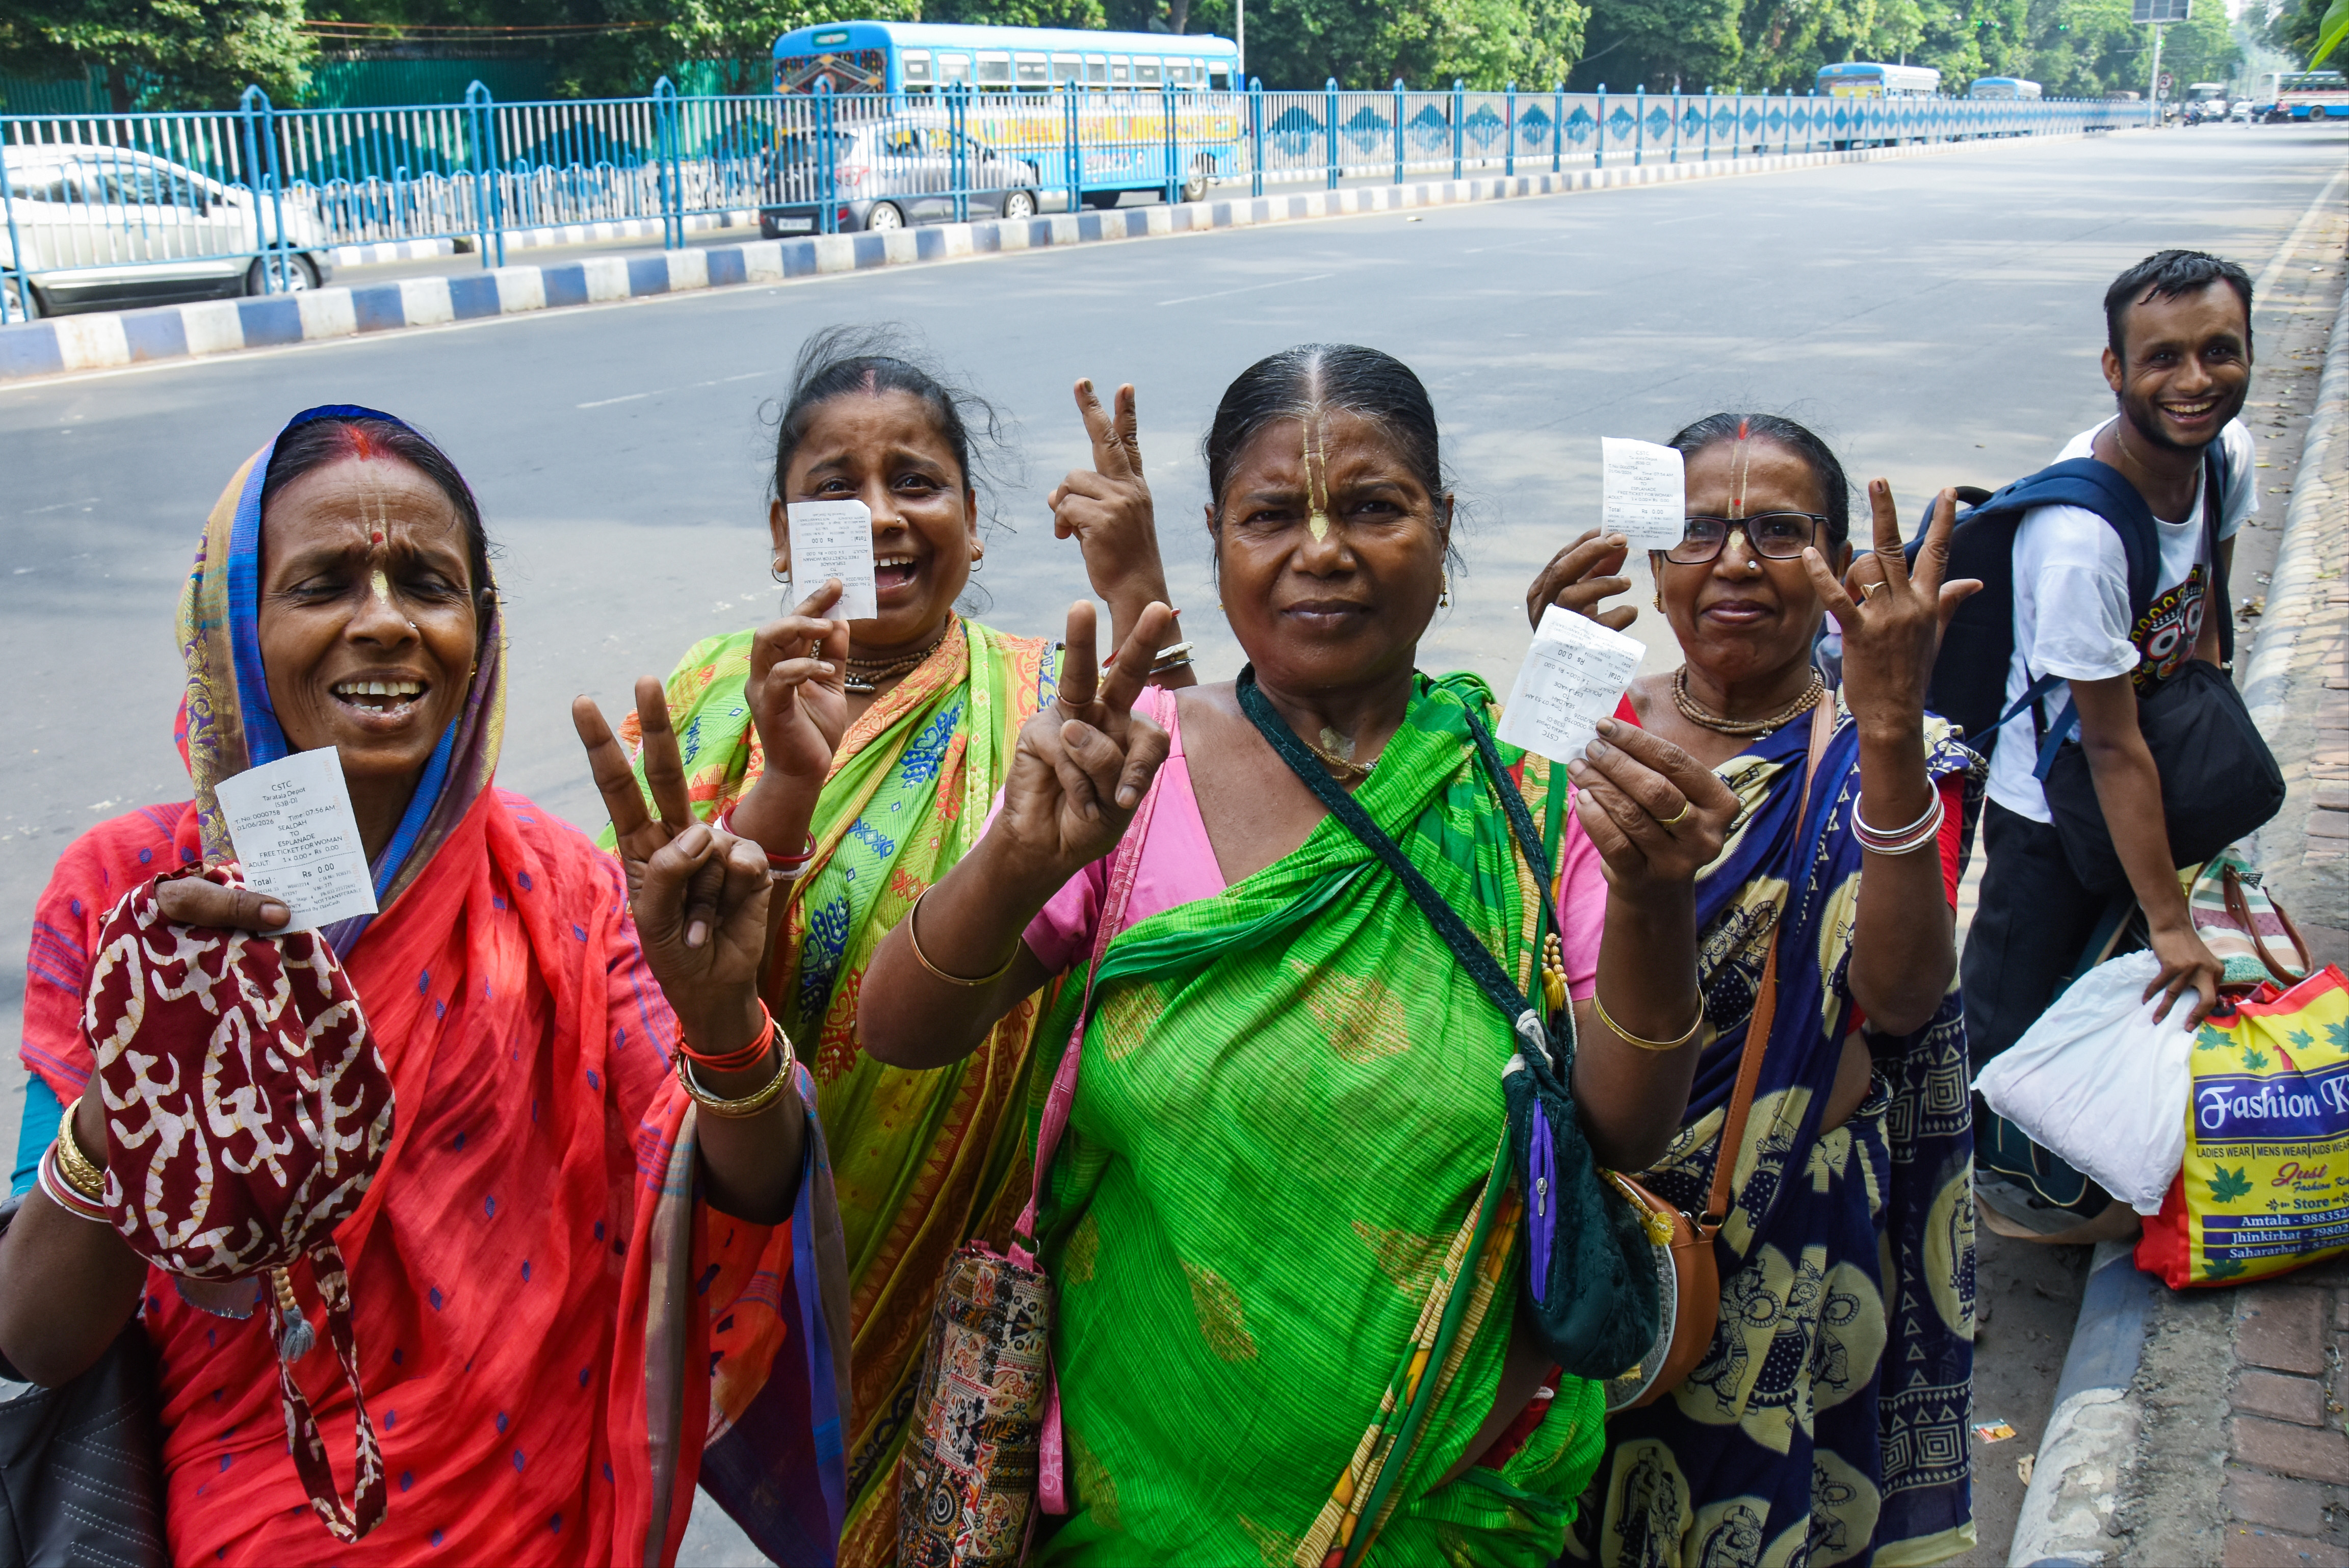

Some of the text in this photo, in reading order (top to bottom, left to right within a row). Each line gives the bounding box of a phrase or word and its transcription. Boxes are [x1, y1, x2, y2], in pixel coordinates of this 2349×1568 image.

[1543, 661, 1556, 670] 0.00
[1557, 648, 1624, 684] Total Rs 0.00
[1569, 672, 1581, 681] 0.00
[1552, 681, 1584, 698] ESPLANADE
[1582, 686, 1602, 698] POLICE
[1551, 695, 1576, 710] SEALDAH
[1535, 718, 1551, 729] Depot
[1563, 716, 1587, 729] 0000750
[1541, 729, 1559, 741] CSTC
[272, 780, 292, 791] CSTC
[287, 787, 305, 797] Depot
[275, 797, 298, 808] (S3B-D)
[253, 810, 280, 819] 0000758
[305, 807, 324, 816] 07:56
[237, 819, 274, 831] 01/06/2026
[278, 820, 307, 831] SEALDAH
[277, 847, 299, 855] TICKET
[300, 843, 314, 851] FOR
[315, 835, 343, 846] WOMAN
[278, 833, 315, 847] ESPLANADE
[253, 877, 272, 887] Total
[318, 863, 334, 873] 0.00
[2199, 1085, 2321, 1129] Fashion
[2197, 1147, 2251, 1158] LADIES WEAR
[2257, 1146, 2308, 1157] MENS WEAR
[2312, 1144, 2331, 1155] KIDS
[2272, 1162, 2328, 1187] Just
[2293, 1198, 2329, 1209] Store
[2241, 1214, 2290, 1226] Amtala
[2231, 1230, 2301, 1245] Jhinkirhat
[2230, 1244, 2301, 1258] Sahararhat
